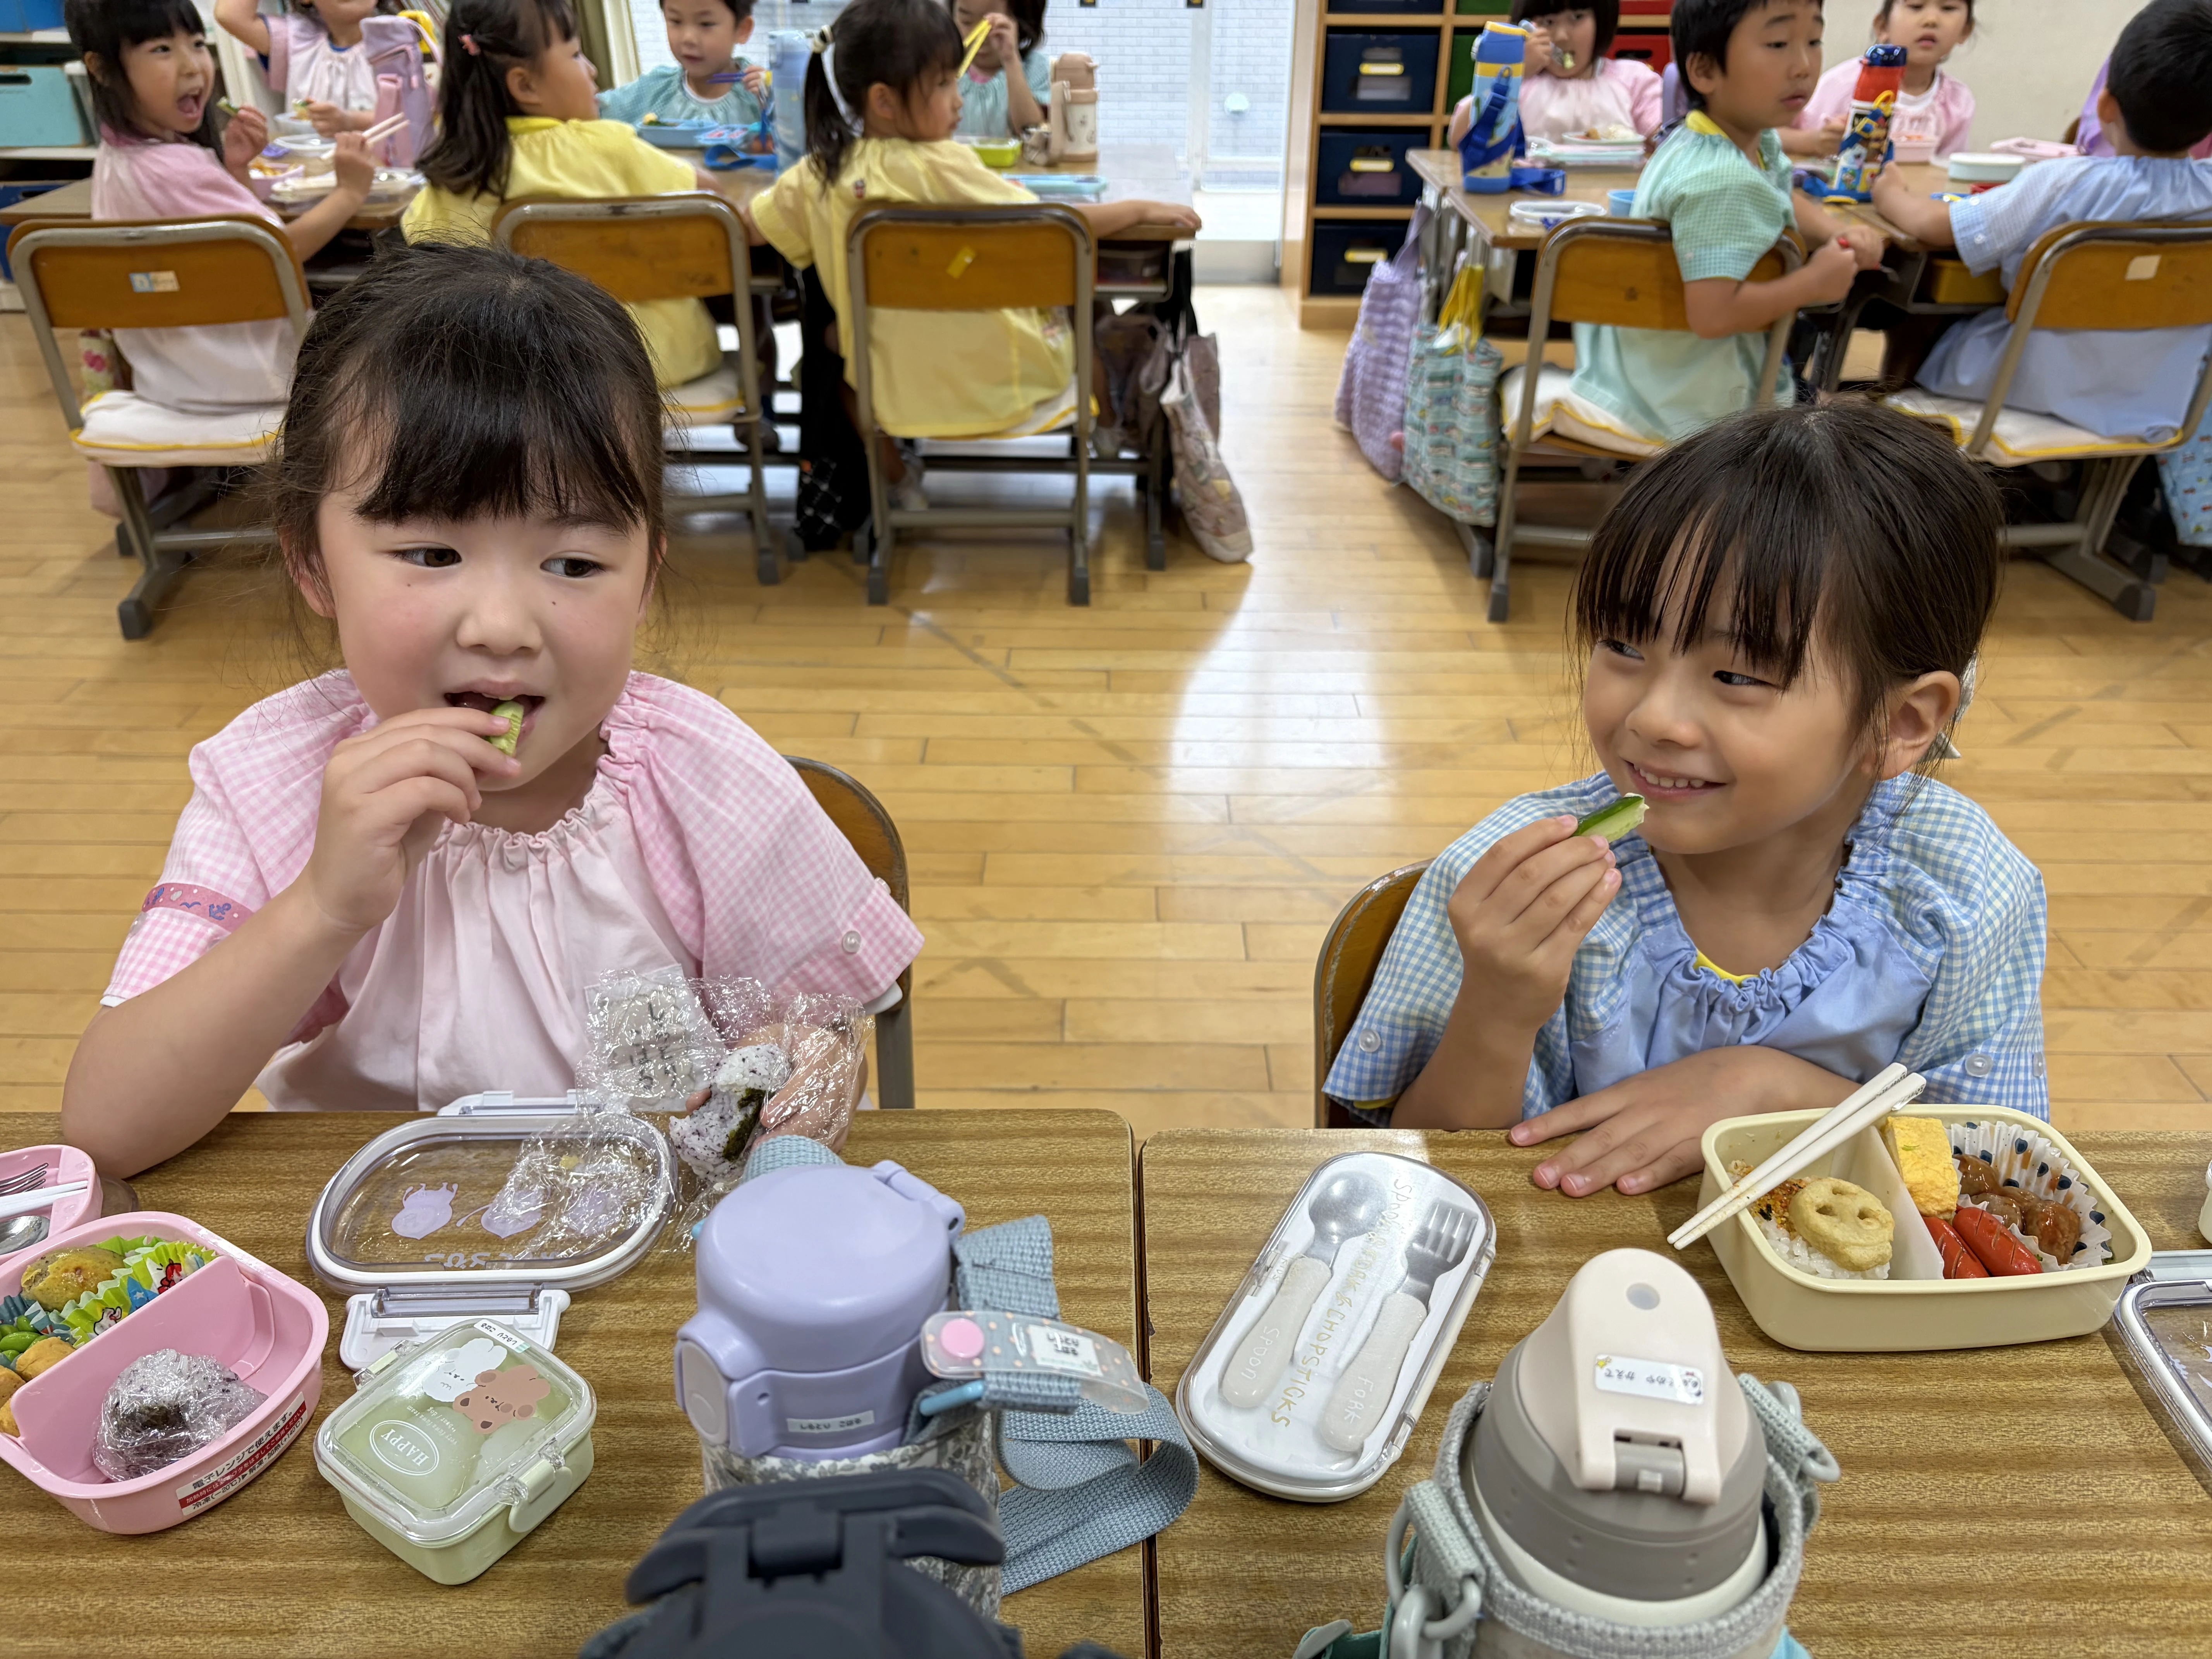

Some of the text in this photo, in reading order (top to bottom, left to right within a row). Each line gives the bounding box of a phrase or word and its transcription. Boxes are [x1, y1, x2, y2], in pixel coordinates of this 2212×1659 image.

[481, 1323, 517, 1345] しらとり こはる
[1271, 1308, 1346, 1427] CHOPSTICKS
[407, 1405, 420, 1416] team
[427, 1406, 438, 1417] dog
[381, 1429, 429, 1466] HAPPY
